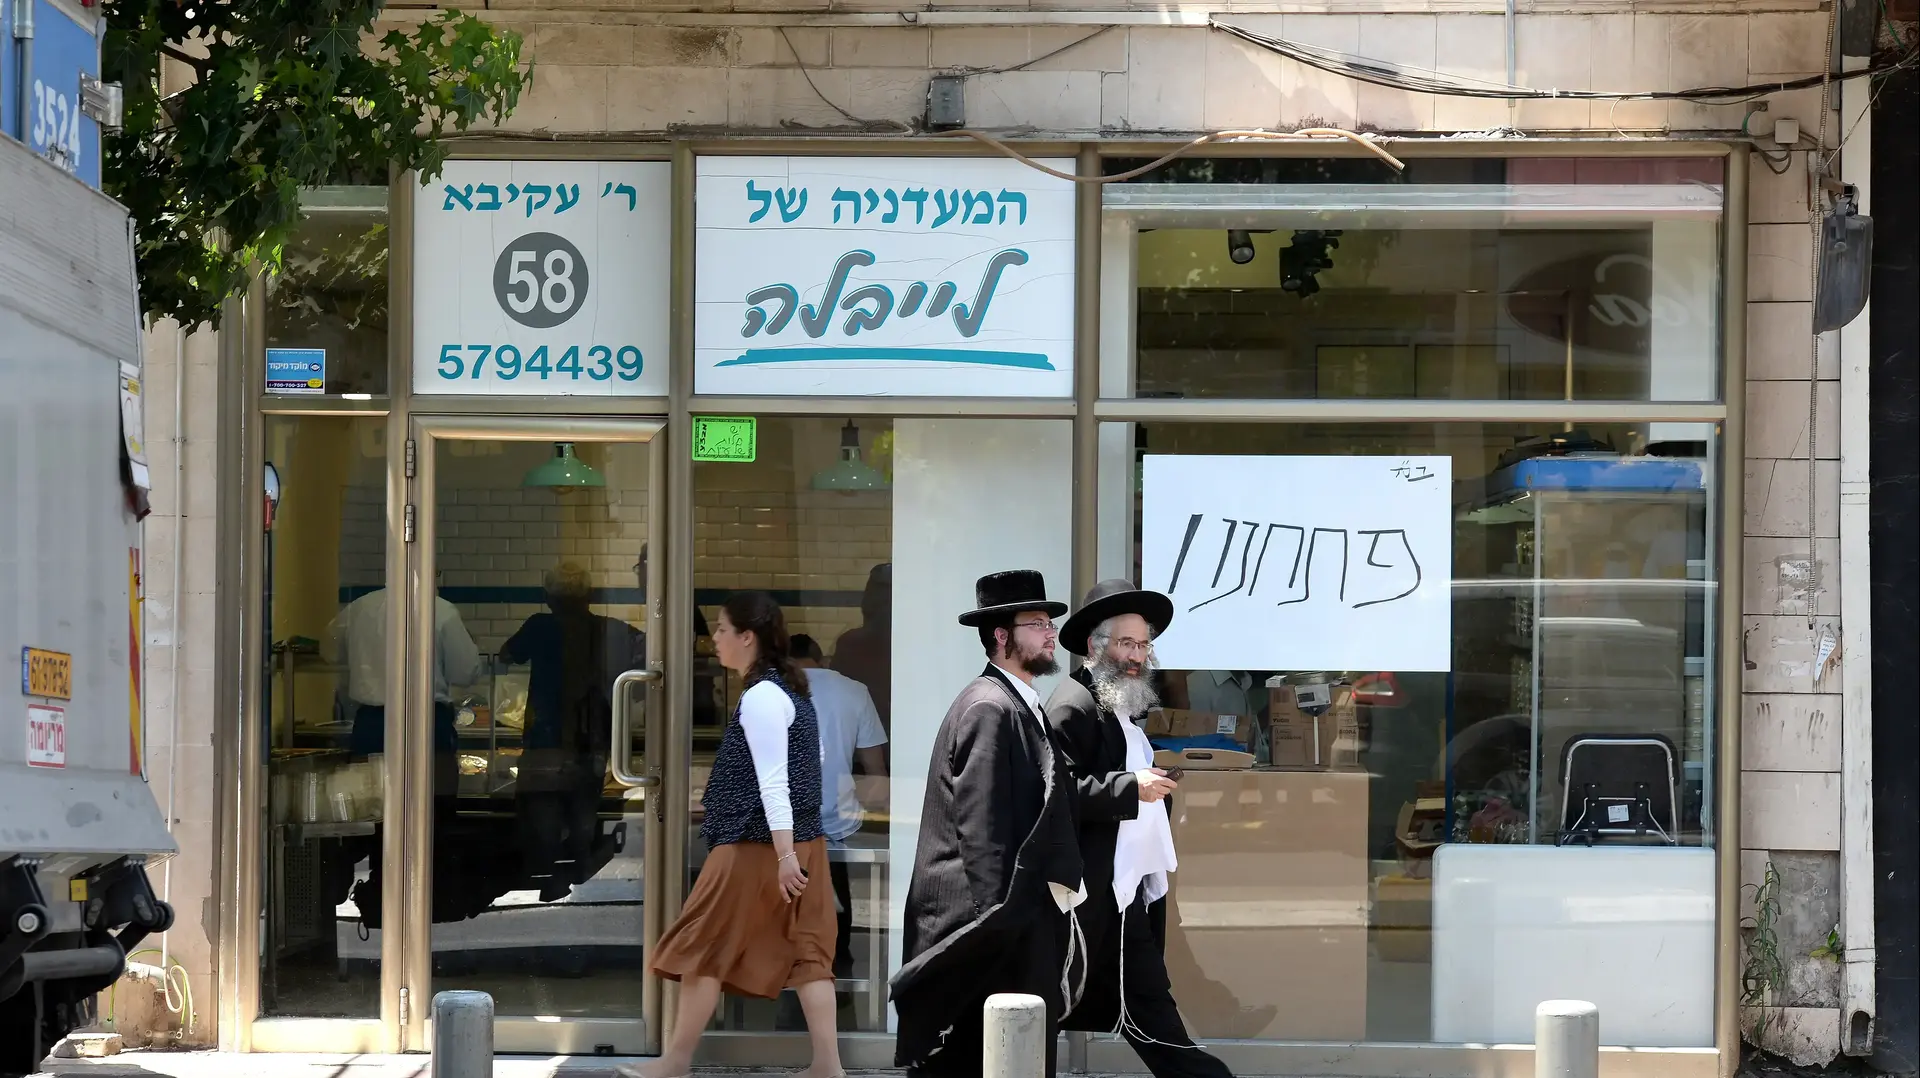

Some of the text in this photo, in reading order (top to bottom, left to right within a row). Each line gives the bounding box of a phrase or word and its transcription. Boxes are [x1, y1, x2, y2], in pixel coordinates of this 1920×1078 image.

[34, 79, 80, 167] 3524
[442, 182, 580, 218] עקיבא
[745, 179, 1027, 229] המעדניה של
[506, 249, 576, 314] 58
[740, 248, 1029, 338] לייבלה
[437, 344, 644, 382] 5794439
